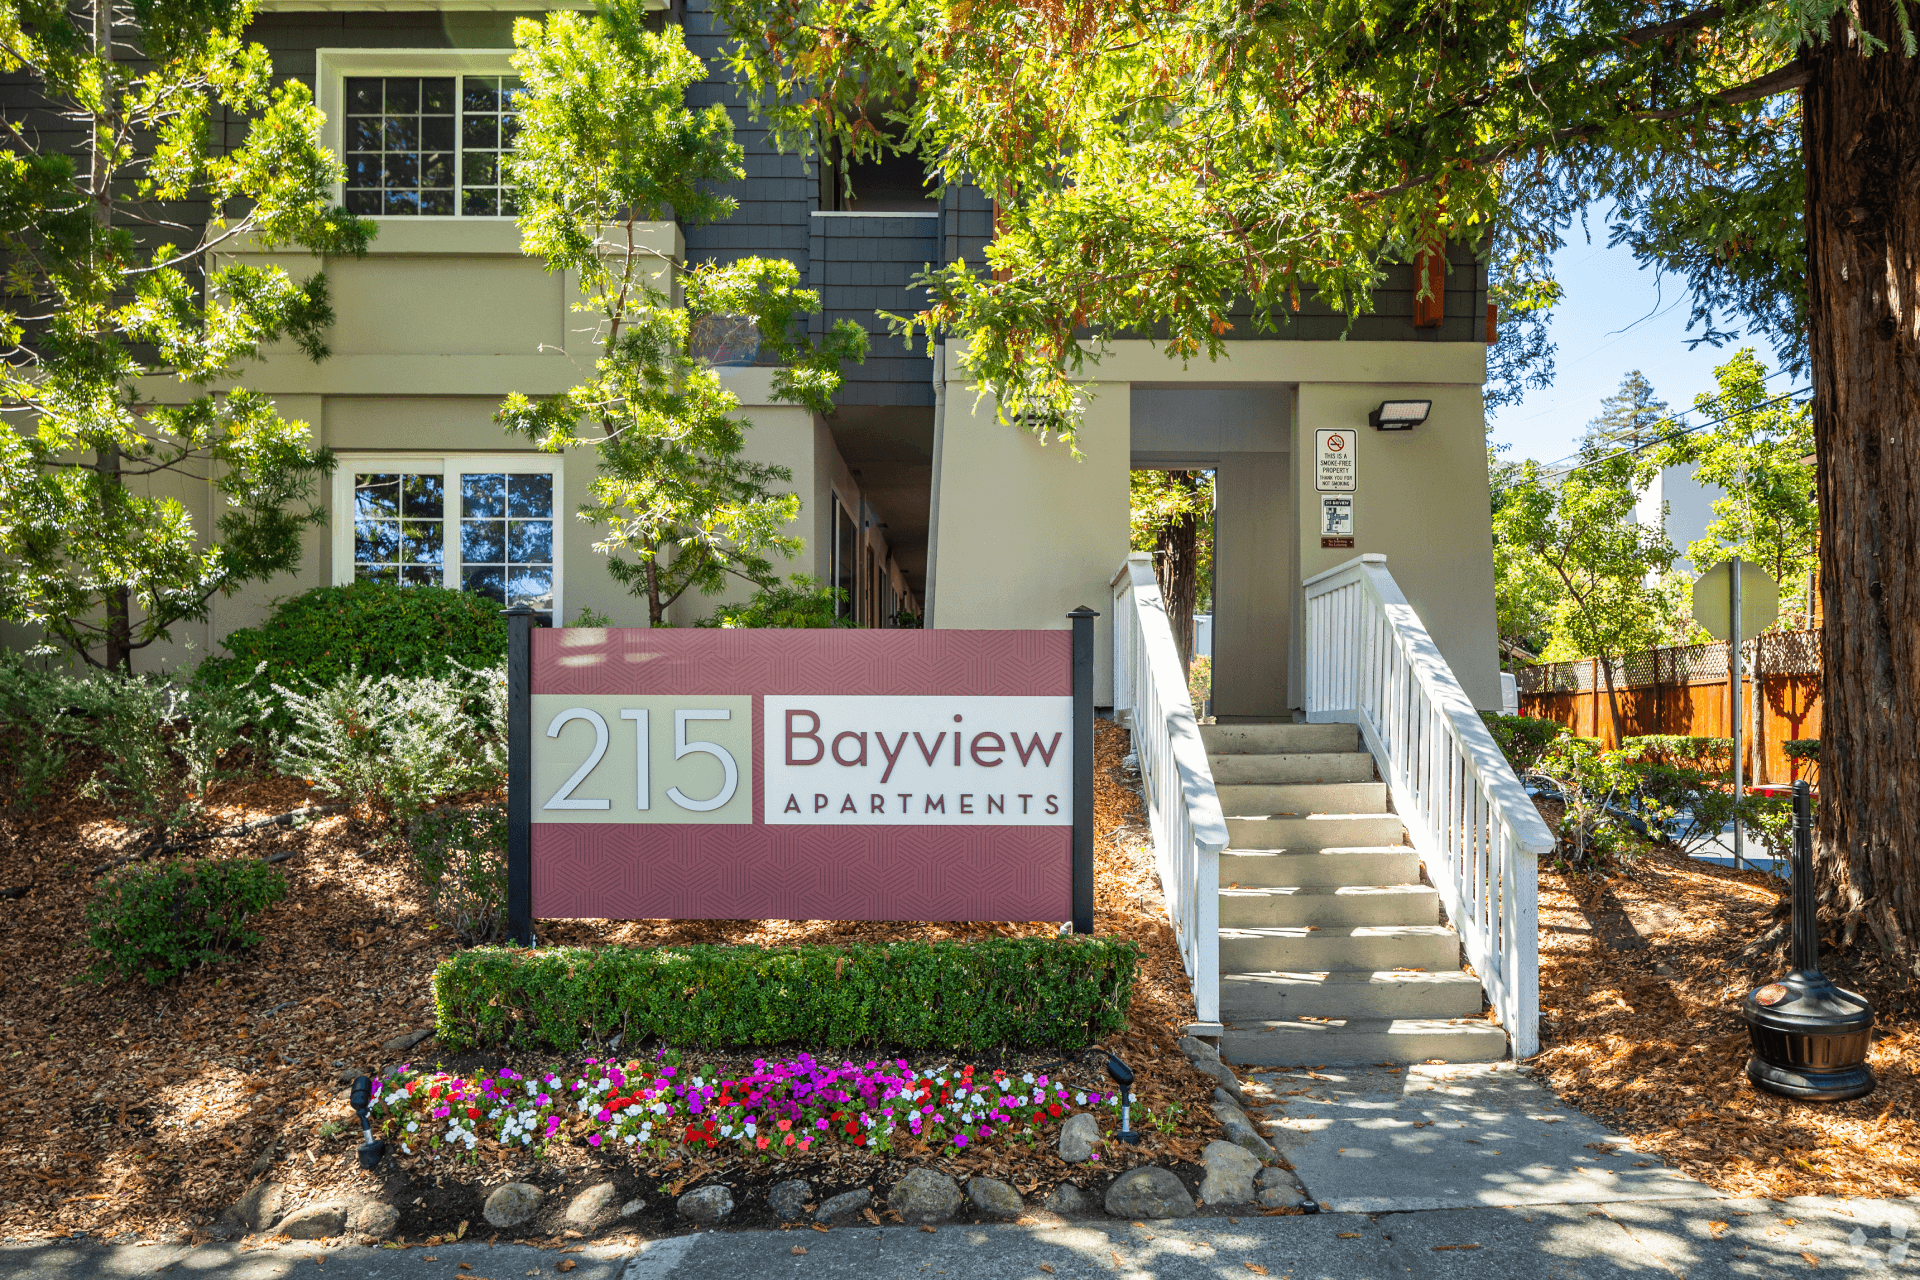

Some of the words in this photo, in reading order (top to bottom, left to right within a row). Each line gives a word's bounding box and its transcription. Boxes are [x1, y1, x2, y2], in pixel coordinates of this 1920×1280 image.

[543, 707, 738, 811] 215
[784, 709, 1063, 783] Bayview
[784, 793, 1060, 814] APARTMENTS
